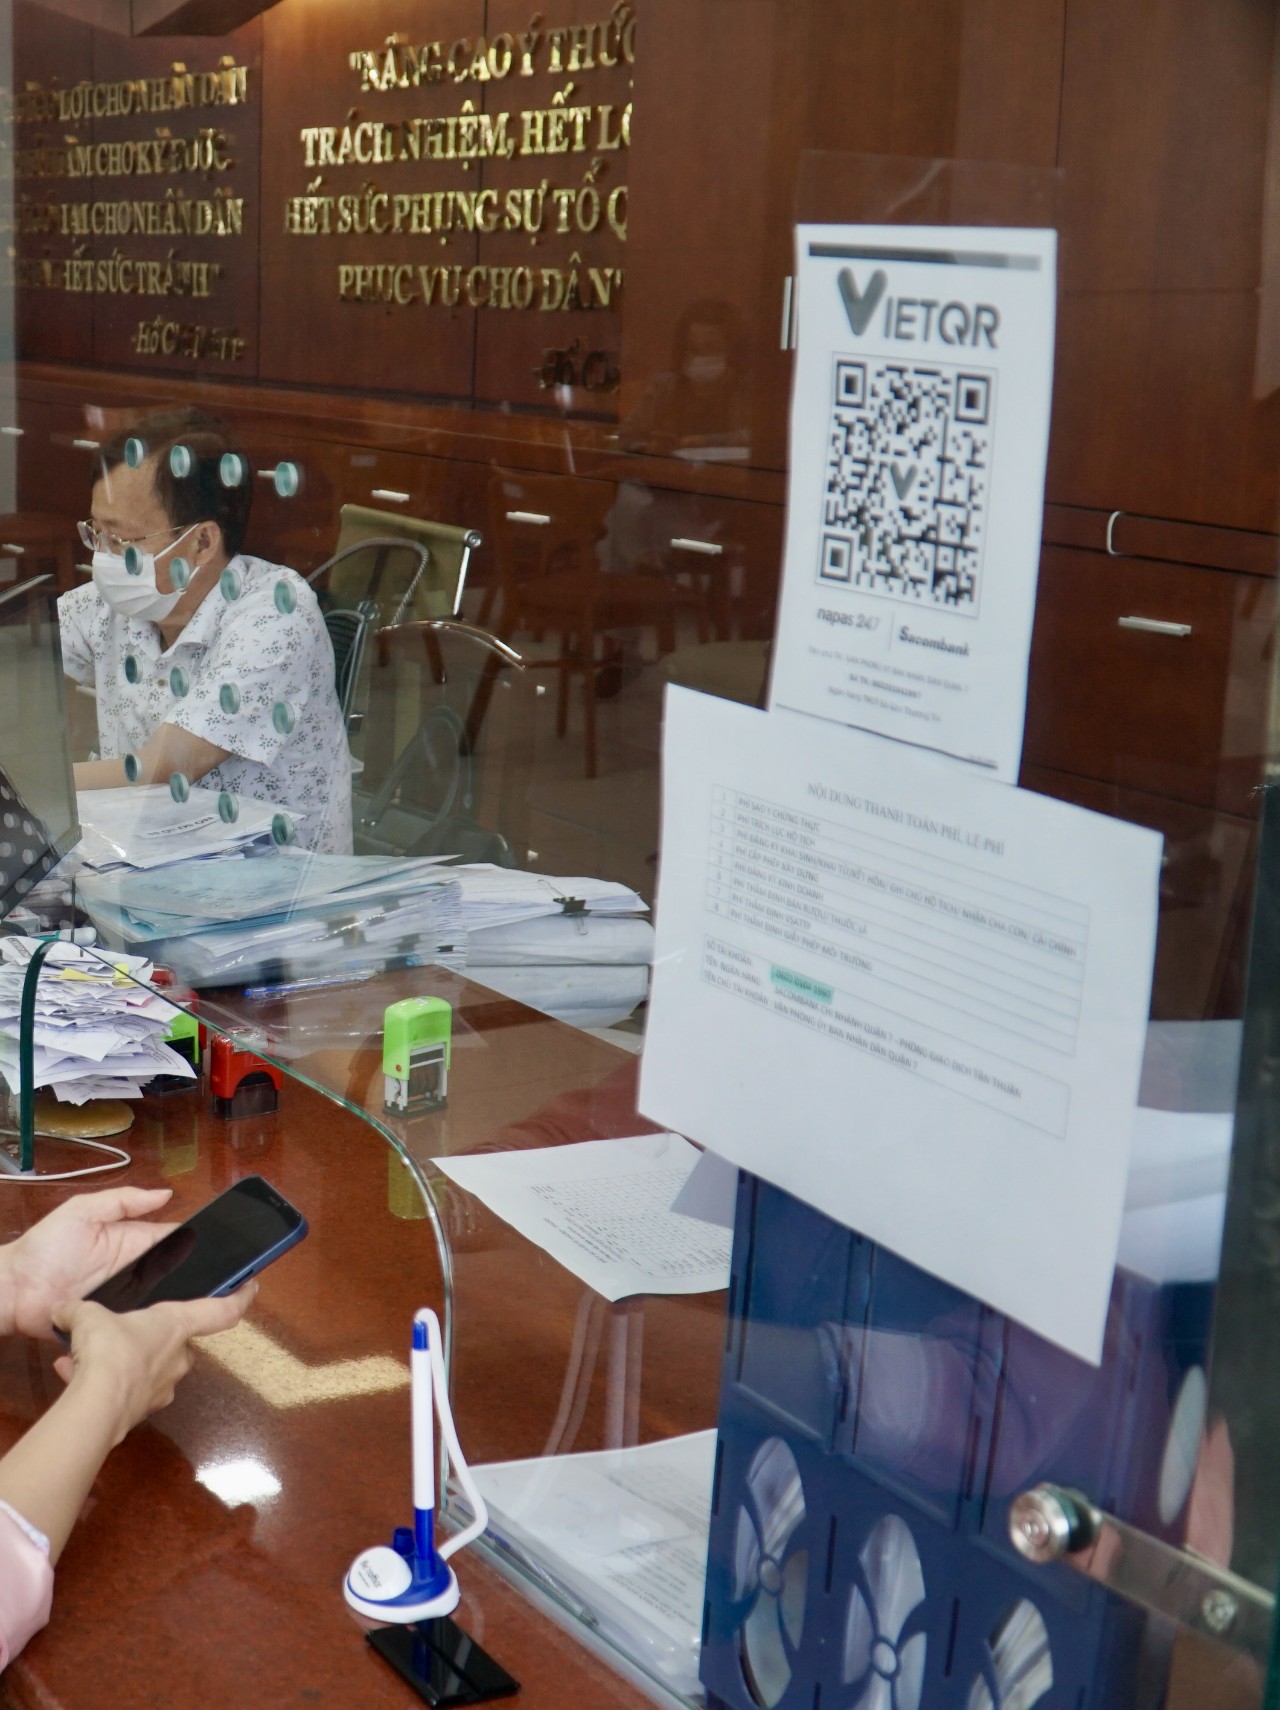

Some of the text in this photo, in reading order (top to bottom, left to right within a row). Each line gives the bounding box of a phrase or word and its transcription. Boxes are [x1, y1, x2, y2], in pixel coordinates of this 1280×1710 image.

[447, 33, 513, 83] CAO
[91, 80, 133, 118] CHO
[300, 106, 395, 168] TRÁCH
[399, 100, 515, 171] NHIỆM,
[521, 81, 592, 155] HẾT
[95, 139, 134, 176] CHO
[91, 201, 133, 236] CHO
[194, 187, 244, 237] DÂN
[284, 175, 336, 234] HẾT
[337, 181, 389, 235] SỨC
[393, 189, 500, 247] PHỤNG
[504, 178, 550, 246] SỰ
[553, 156, 602, 233] TỔ
[468, 266, 535, 311] CHO
[837, 266, 1001, 349] VIETQR
[817, 607, 855, 627] napas
[899, 625, 970, 657] Sacombank
[829, 789, 862, 810] DUNG
[863, 800, 904, 824] THANH
